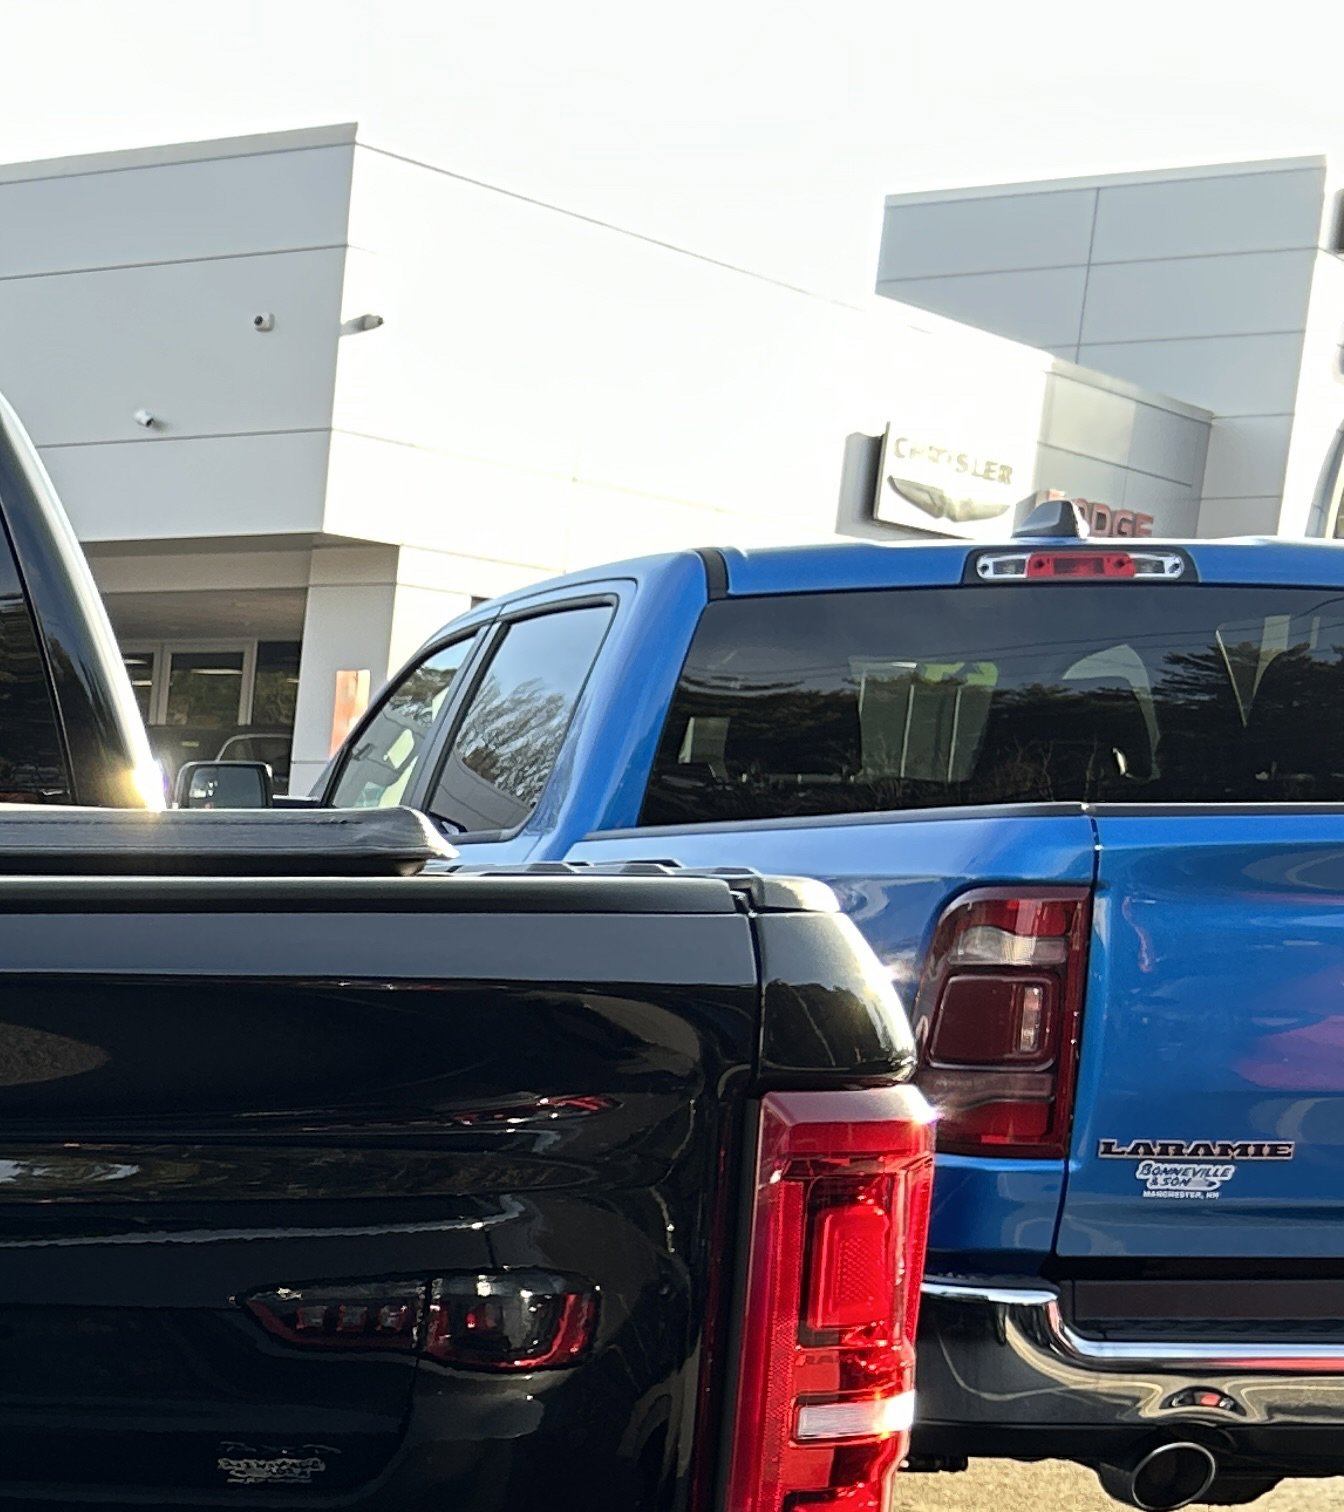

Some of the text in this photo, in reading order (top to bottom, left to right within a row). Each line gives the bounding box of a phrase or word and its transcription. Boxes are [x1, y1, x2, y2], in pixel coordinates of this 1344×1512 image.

[894, 437, 1012, 484] CSLER
[1048, 489, 1153, 537] ODGE
[1098, 1139, 1295, 1160] LARAMIE
[1139, 1163, 1231, 1178] BONNEVILLE
[1161, 1177, 1192, 1187] SON
